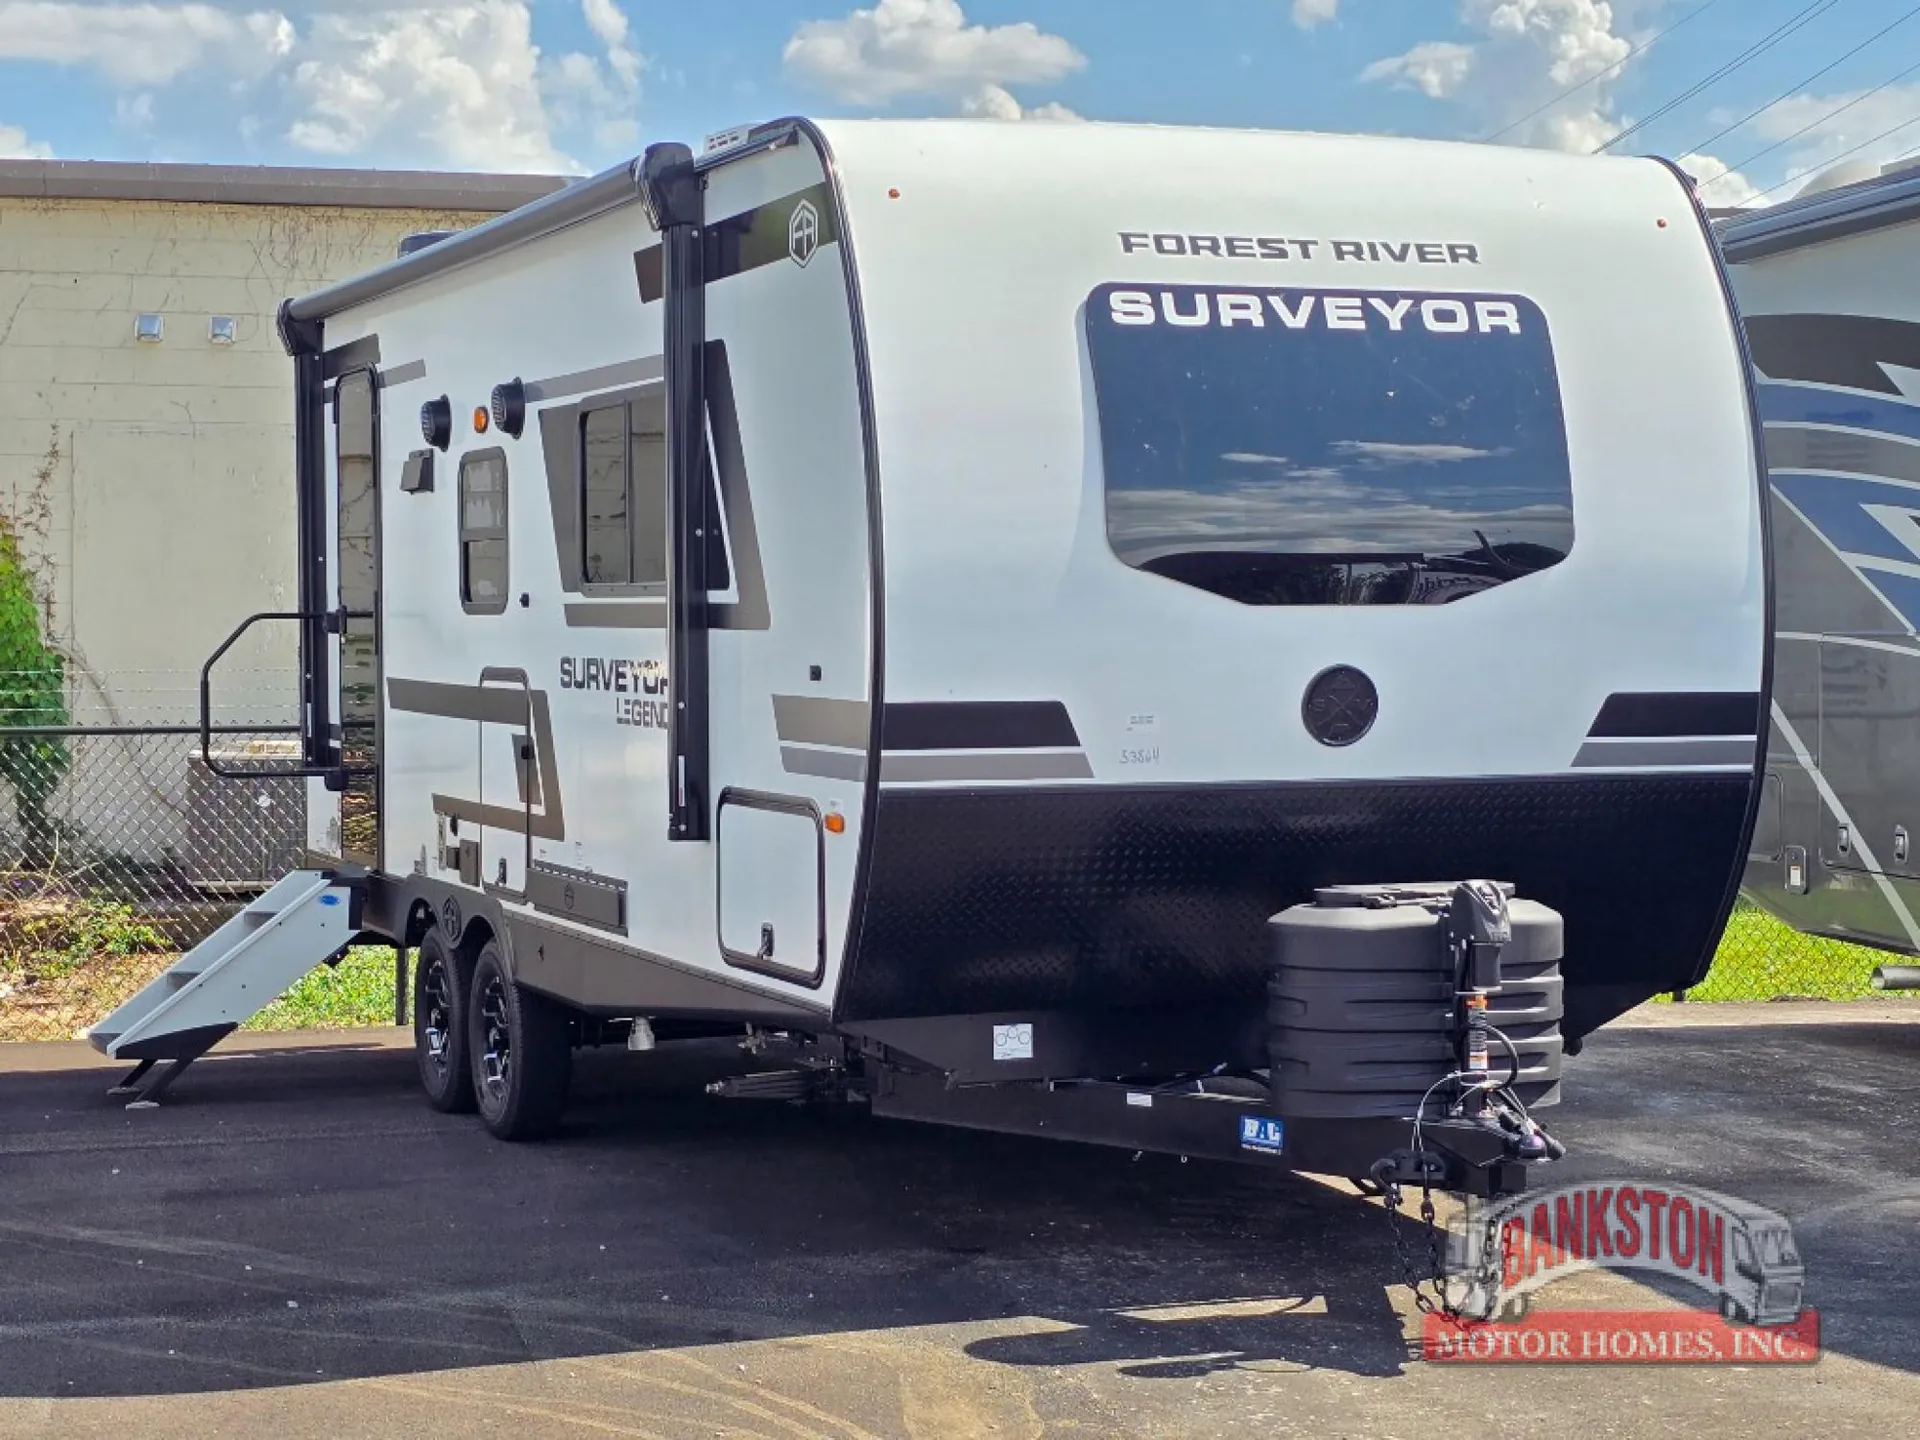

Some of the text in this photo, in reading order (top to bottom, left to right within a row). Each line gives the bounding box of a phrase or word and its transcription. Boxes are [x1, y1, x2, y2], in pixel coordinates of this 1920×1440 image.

[1118, 231, 1481, 265] FOREST RIVER
[1109, 290, 1521, 335] SURVEYOR
